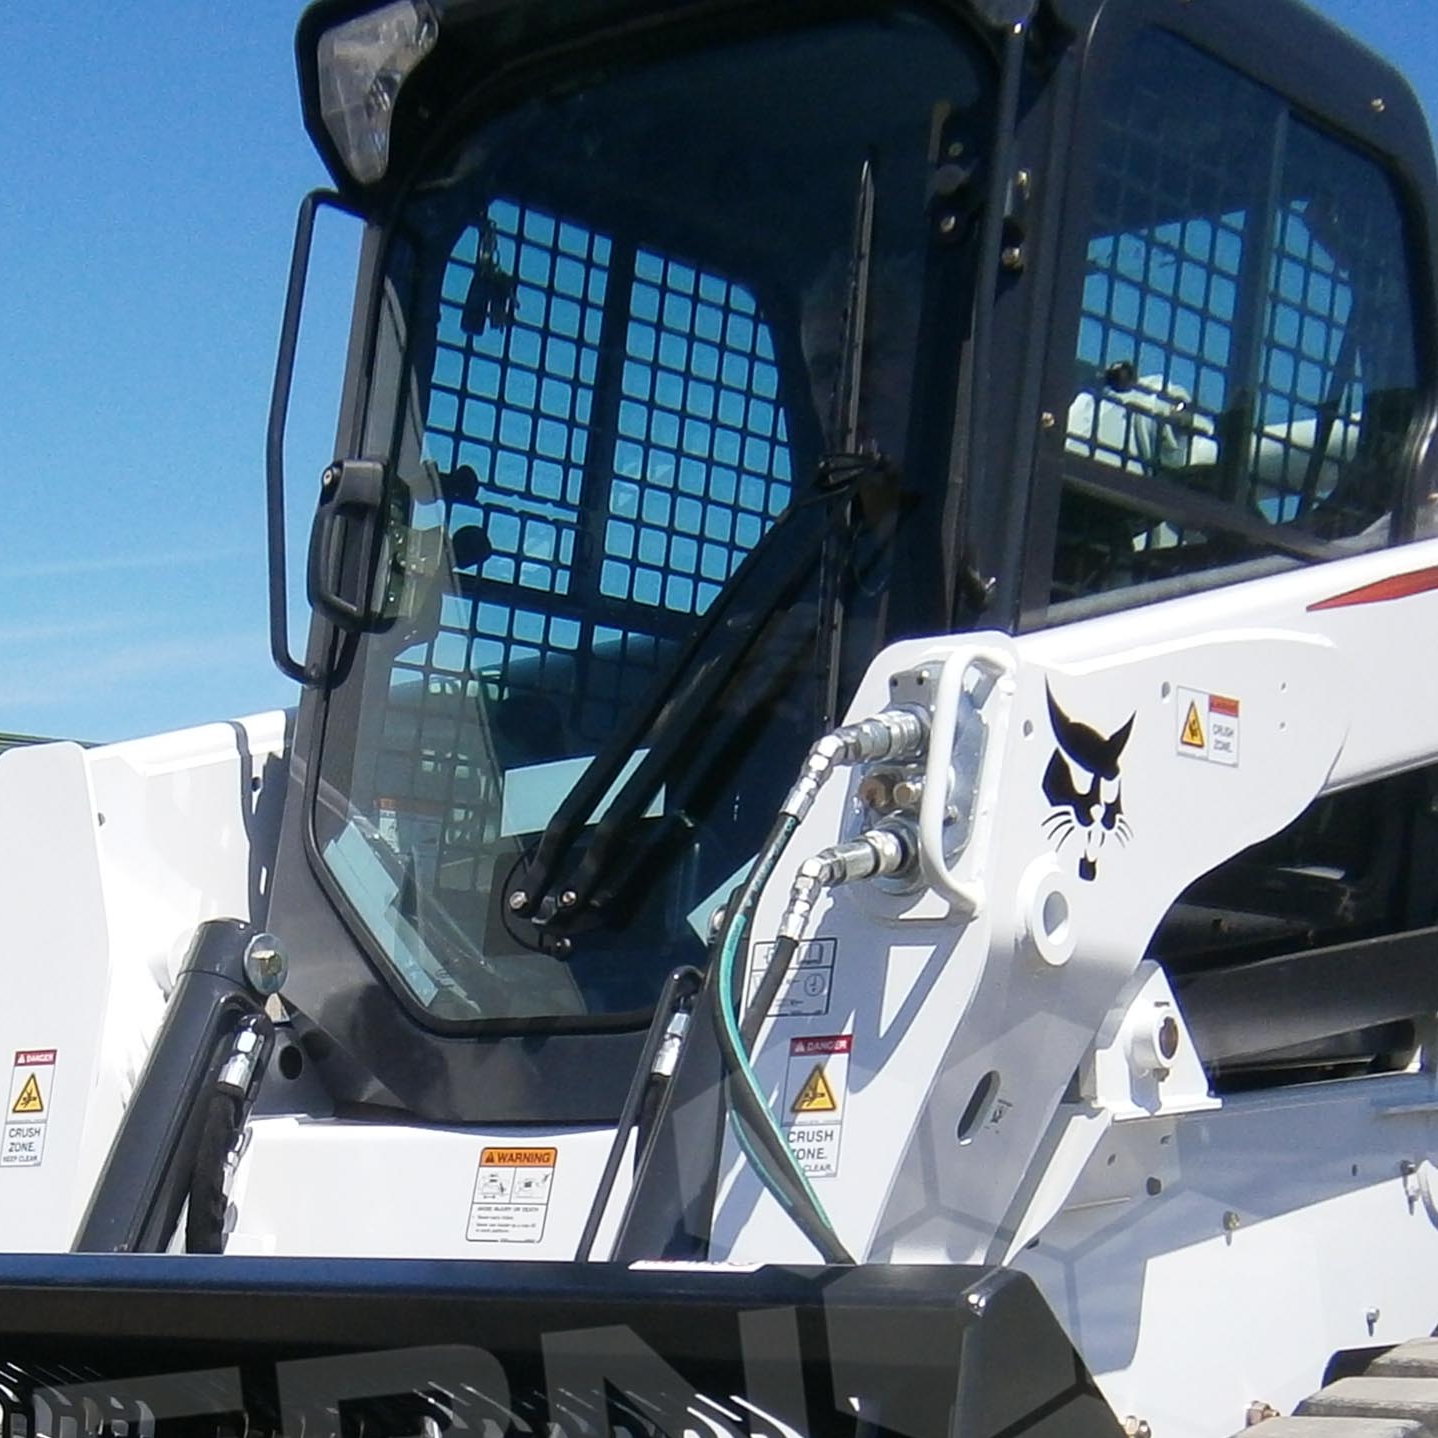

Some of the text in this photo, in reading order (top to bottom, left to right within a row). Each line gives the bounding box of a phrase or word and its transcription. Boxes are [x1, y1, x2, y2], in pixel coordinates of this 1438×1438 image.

[806, 1039, 848, 1052] DANGER
[8, 1127, 41, 1139] CRUSH
[787, 1129, 834, 1144] CRUSH
[497, 1152, 552, 1164] WARNING
